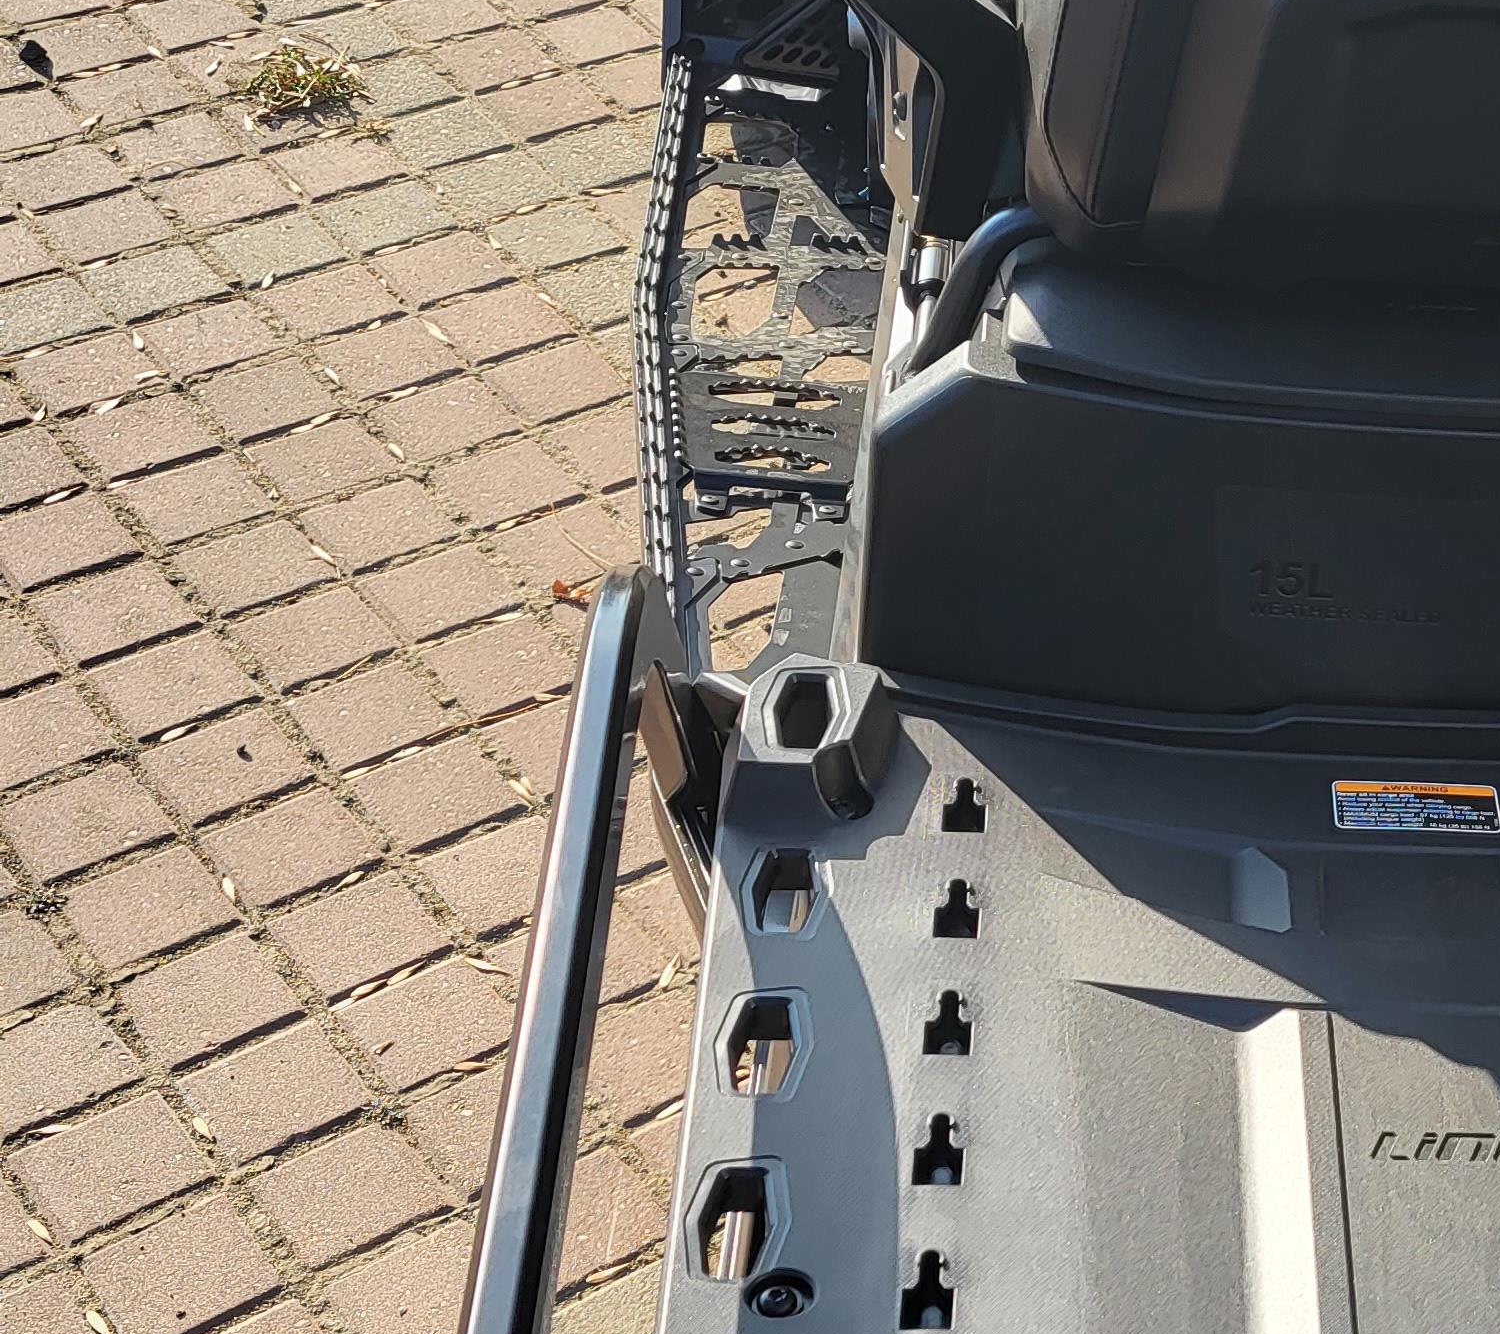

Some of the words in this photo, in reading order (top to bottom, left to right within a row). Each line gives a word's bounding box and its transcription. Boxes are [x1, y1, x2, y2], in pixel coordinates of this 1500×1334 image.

[1248, 560, 1334, 601] 15L
[1248, 601, 1351, 620] WEATHER
[1360, 609, 1441, 625] SEALED
